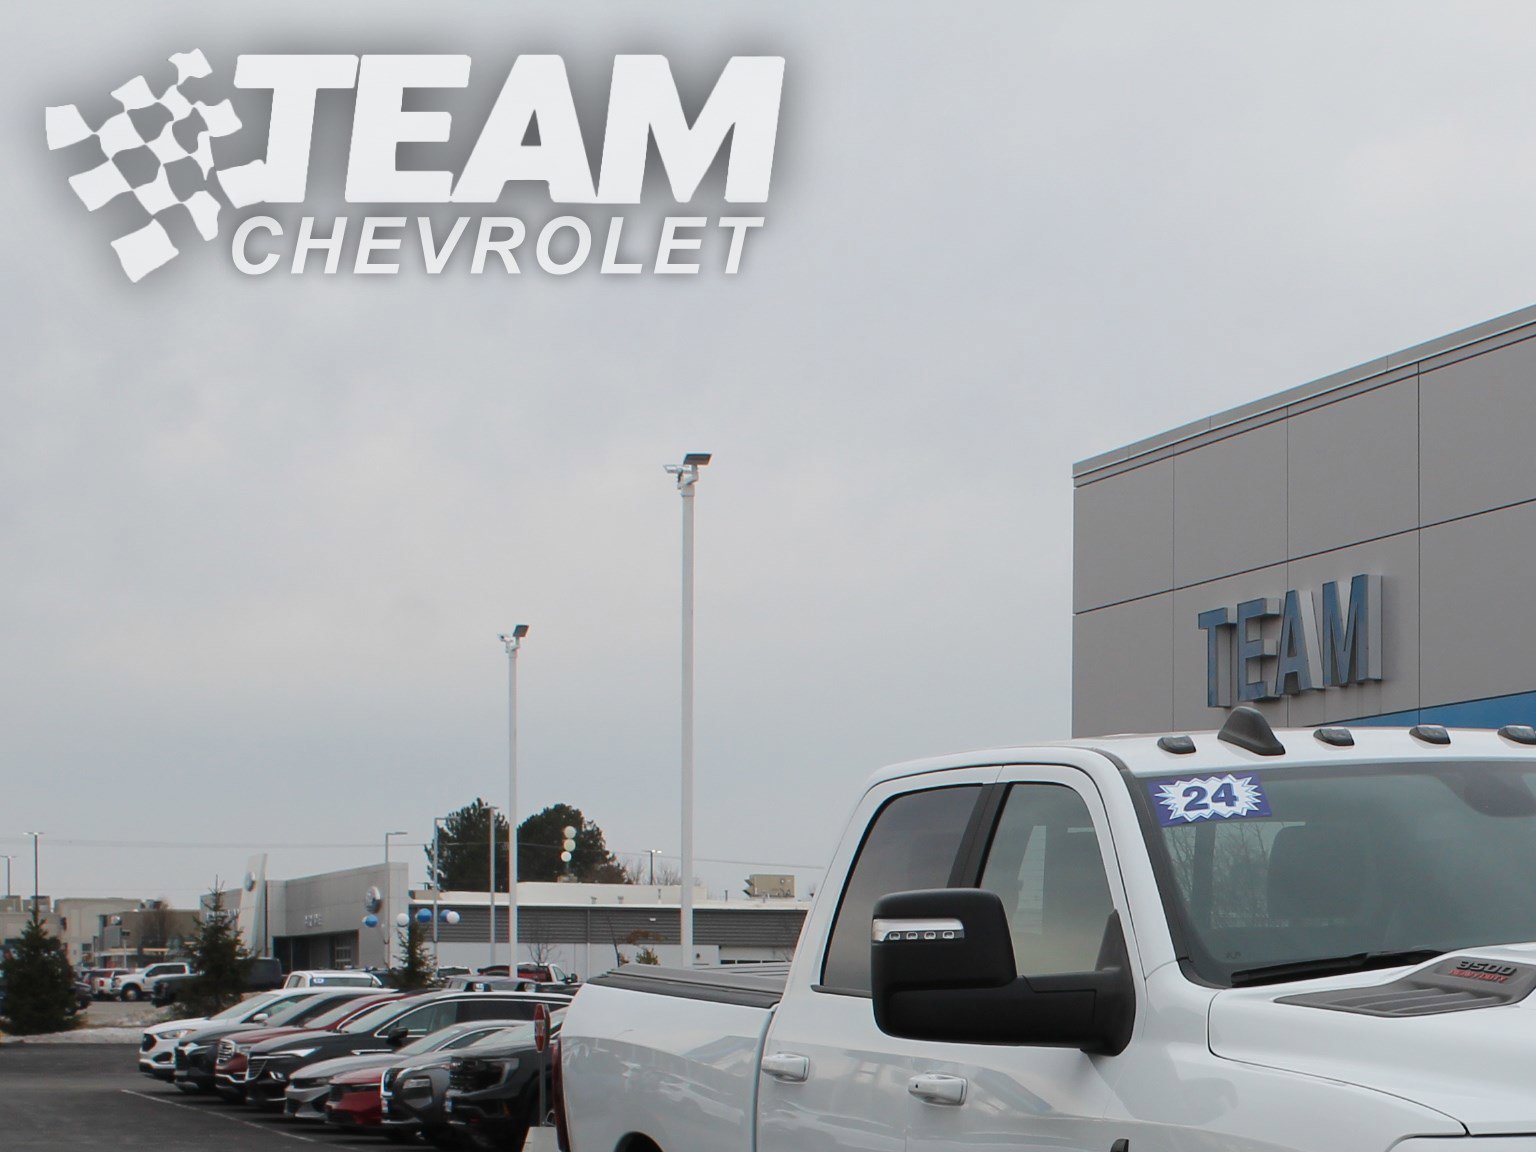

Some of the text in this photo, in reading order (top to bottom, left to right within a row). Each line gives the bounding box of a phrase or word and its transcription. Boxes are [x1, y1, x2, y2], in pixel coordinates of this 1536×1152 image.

[1197, 573, 1383, 708] TEAM
[1181, 782, 1239, 812] 24
[1456, 960, 1517, 976] 3500
